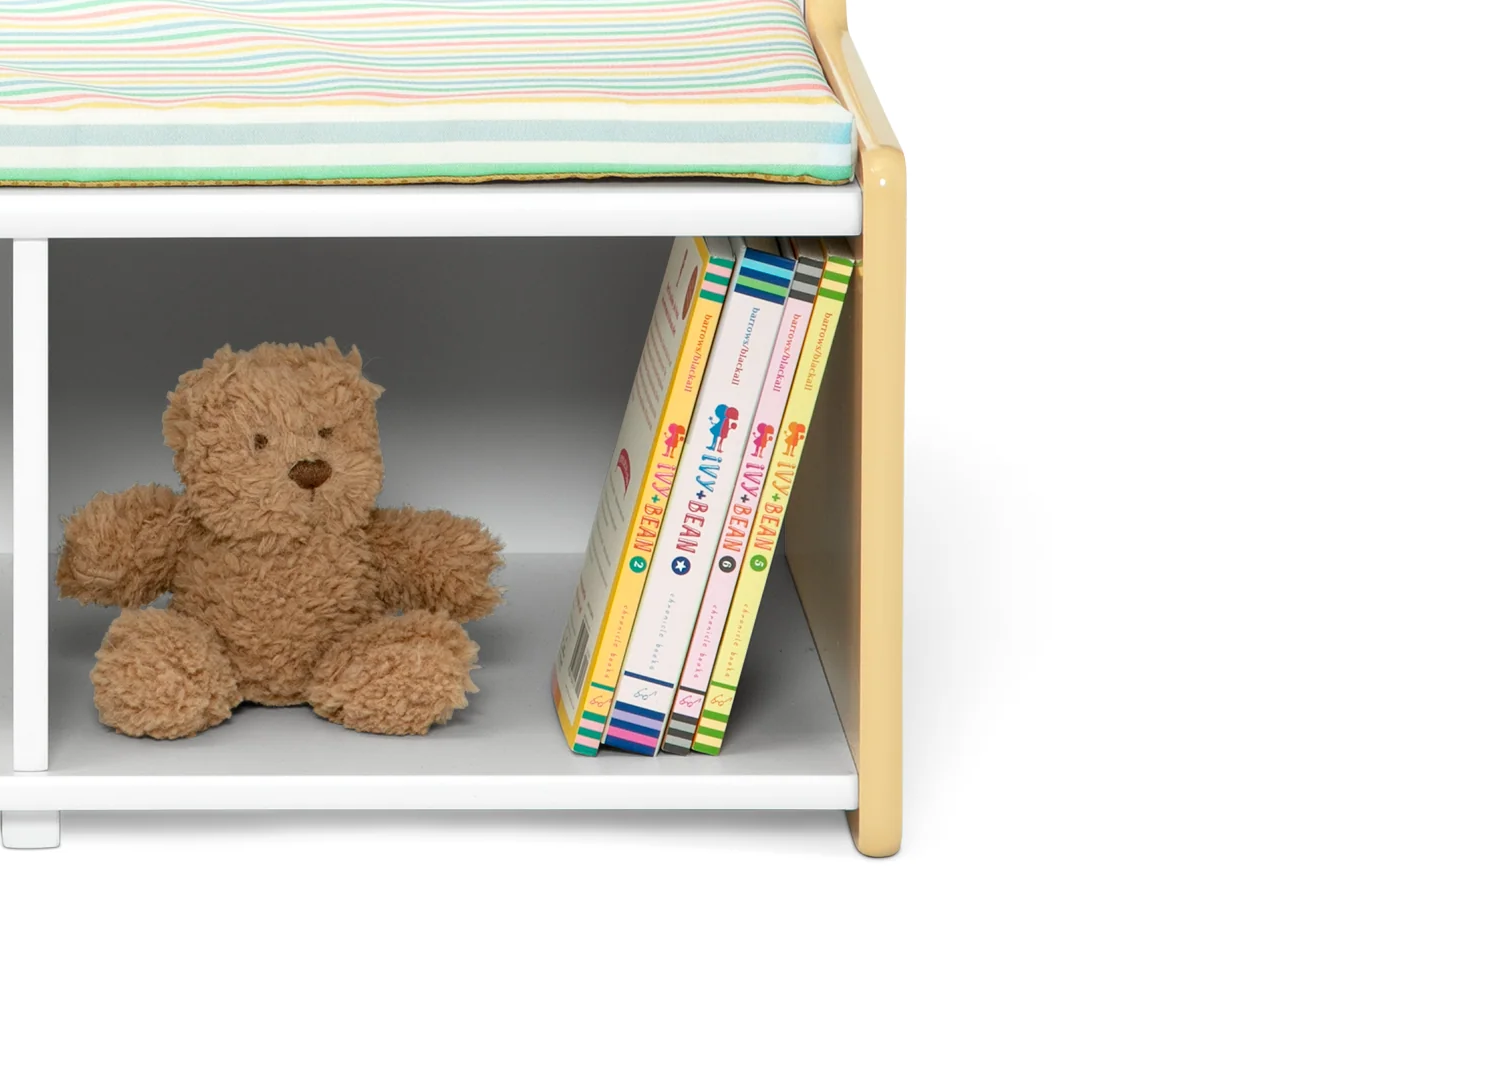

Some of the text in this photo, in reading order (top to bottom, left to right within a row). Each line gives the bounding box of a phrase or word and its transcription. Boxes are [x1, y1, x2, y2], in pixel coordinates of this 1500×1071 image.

[684, 314, 713, 392] barrows/blackall
[731, 307, 760, 386] barrows/blackall
[772, 313, 801, 392] barrows/blackall
[804, 312, 833, 391] barrows/blackall
[604, 605, 628, 679] chronicle books
[649, 593, 675, 671] chronicle books
[693, 604, 718, 679] chronicle books
[724, 603, 749, 678] chronicle books
